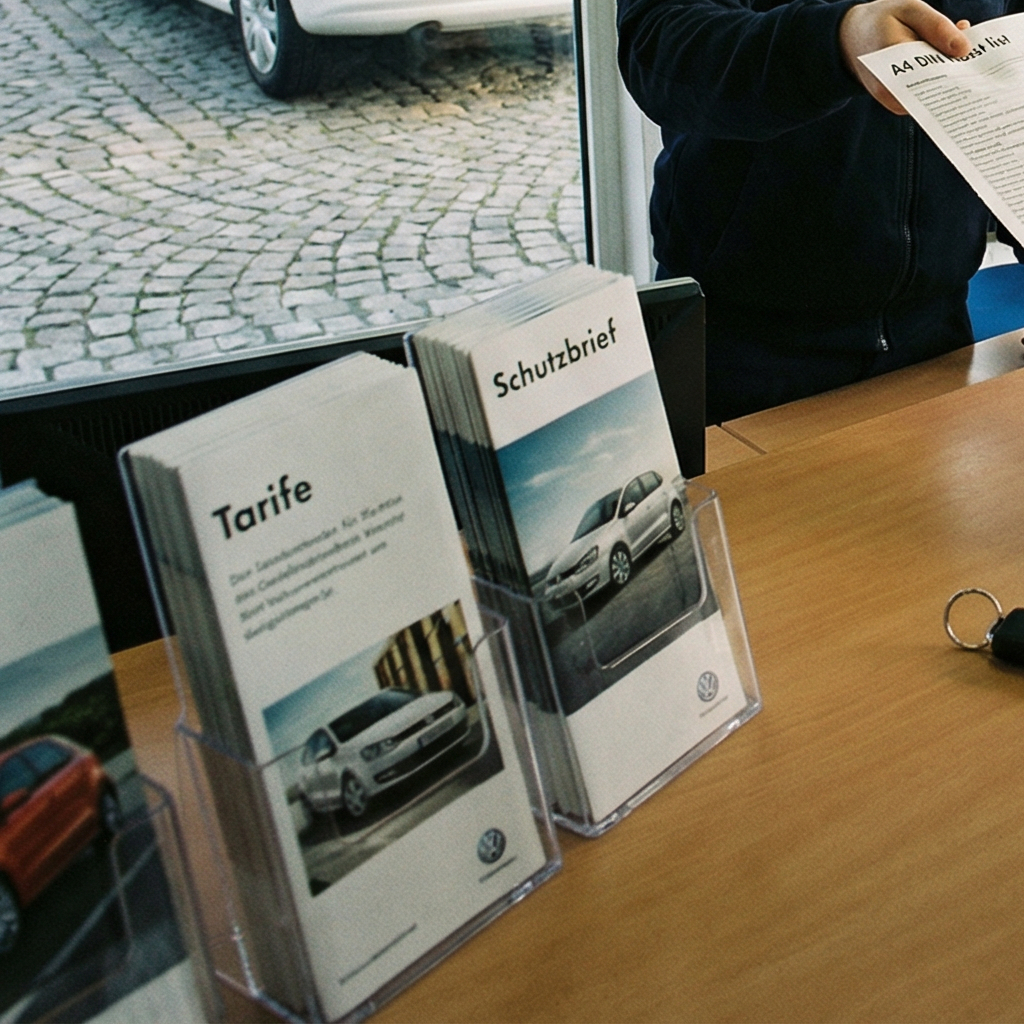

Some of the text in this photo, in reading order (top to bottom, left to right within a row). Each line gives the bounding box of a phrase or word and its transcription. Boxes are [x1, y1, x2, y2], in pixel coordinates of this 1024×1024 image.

[891, 60, 914, 76] A4
[493, 317, 616, 398] Schutzbrief
[211, 474, 312, 540] Tarife
